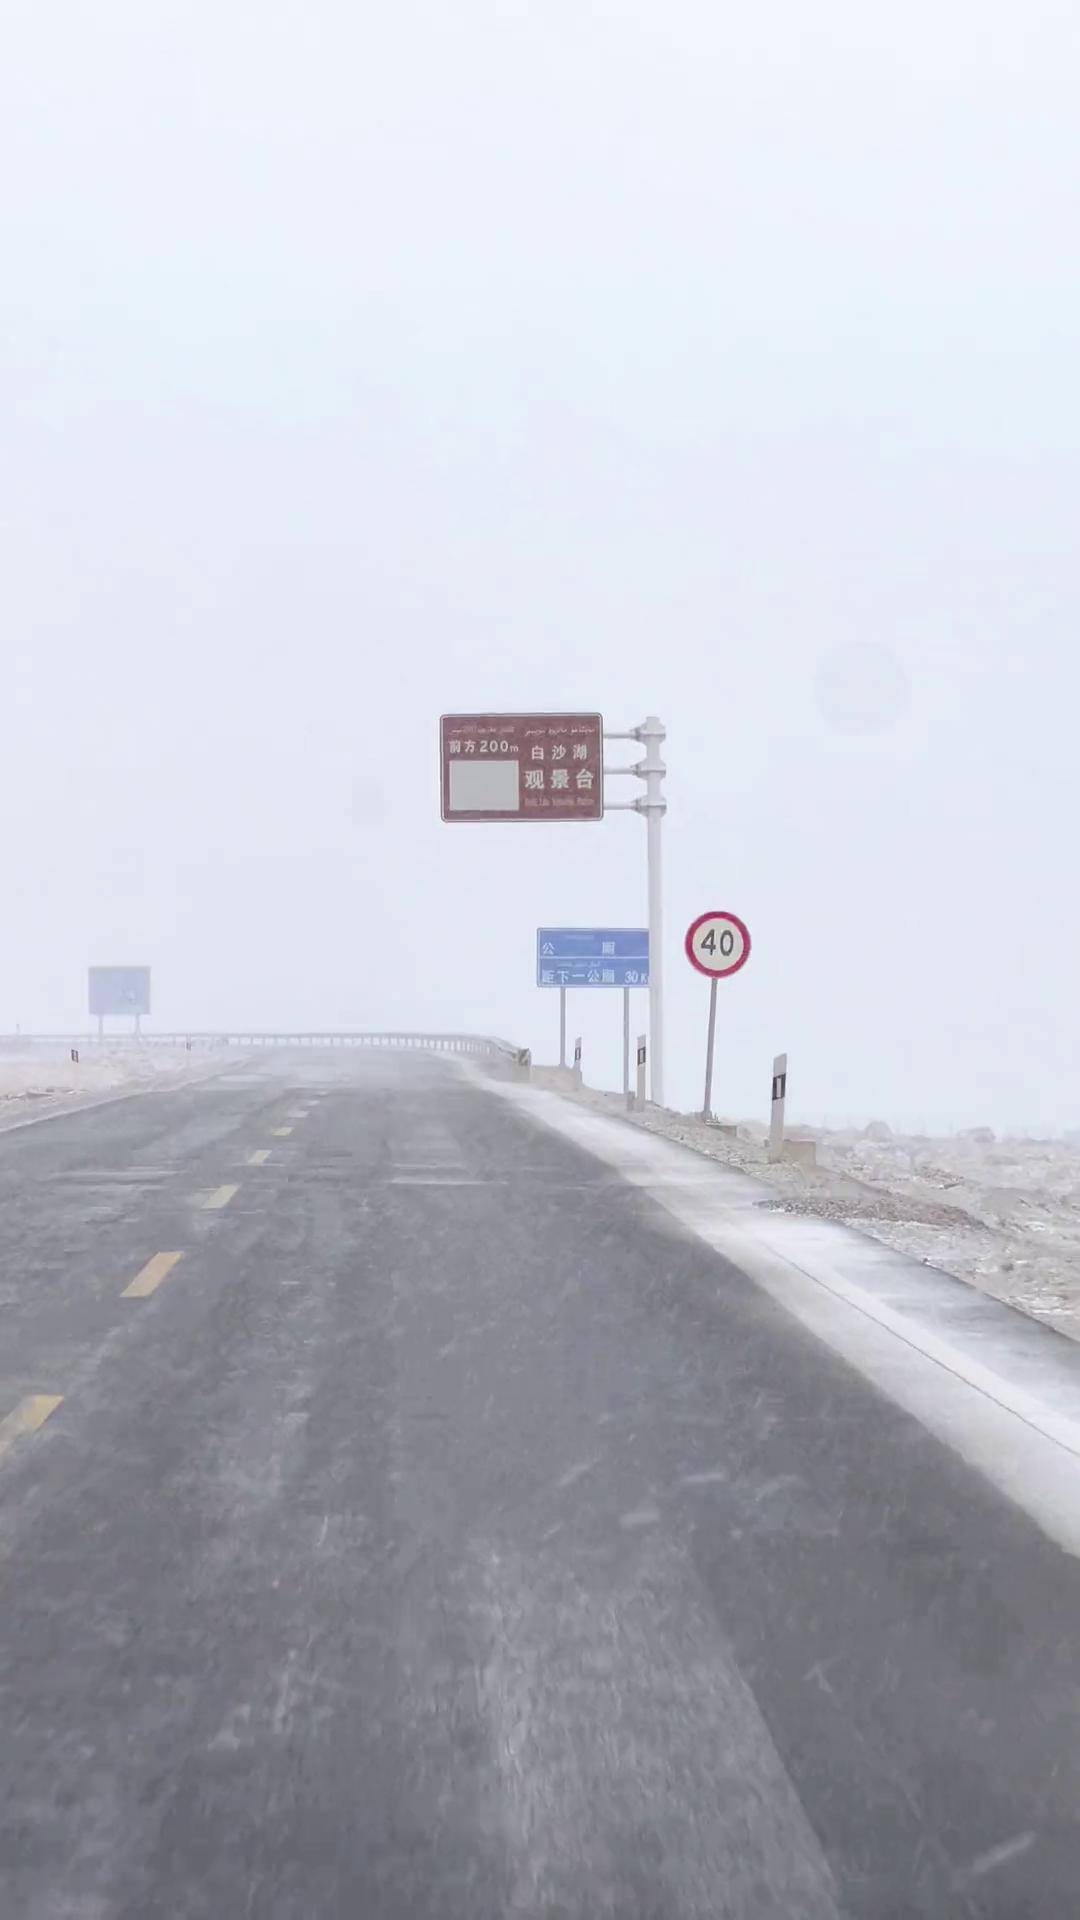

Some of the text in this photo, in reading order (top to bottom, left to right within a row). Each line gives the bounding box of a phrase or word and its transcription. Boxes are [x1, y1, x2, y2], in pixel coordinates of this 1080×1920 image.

[531, 745, 587, 760] 白沙湖
[525, 769, 595, 789] 观景台
[701, 928, 734, 957] 40
